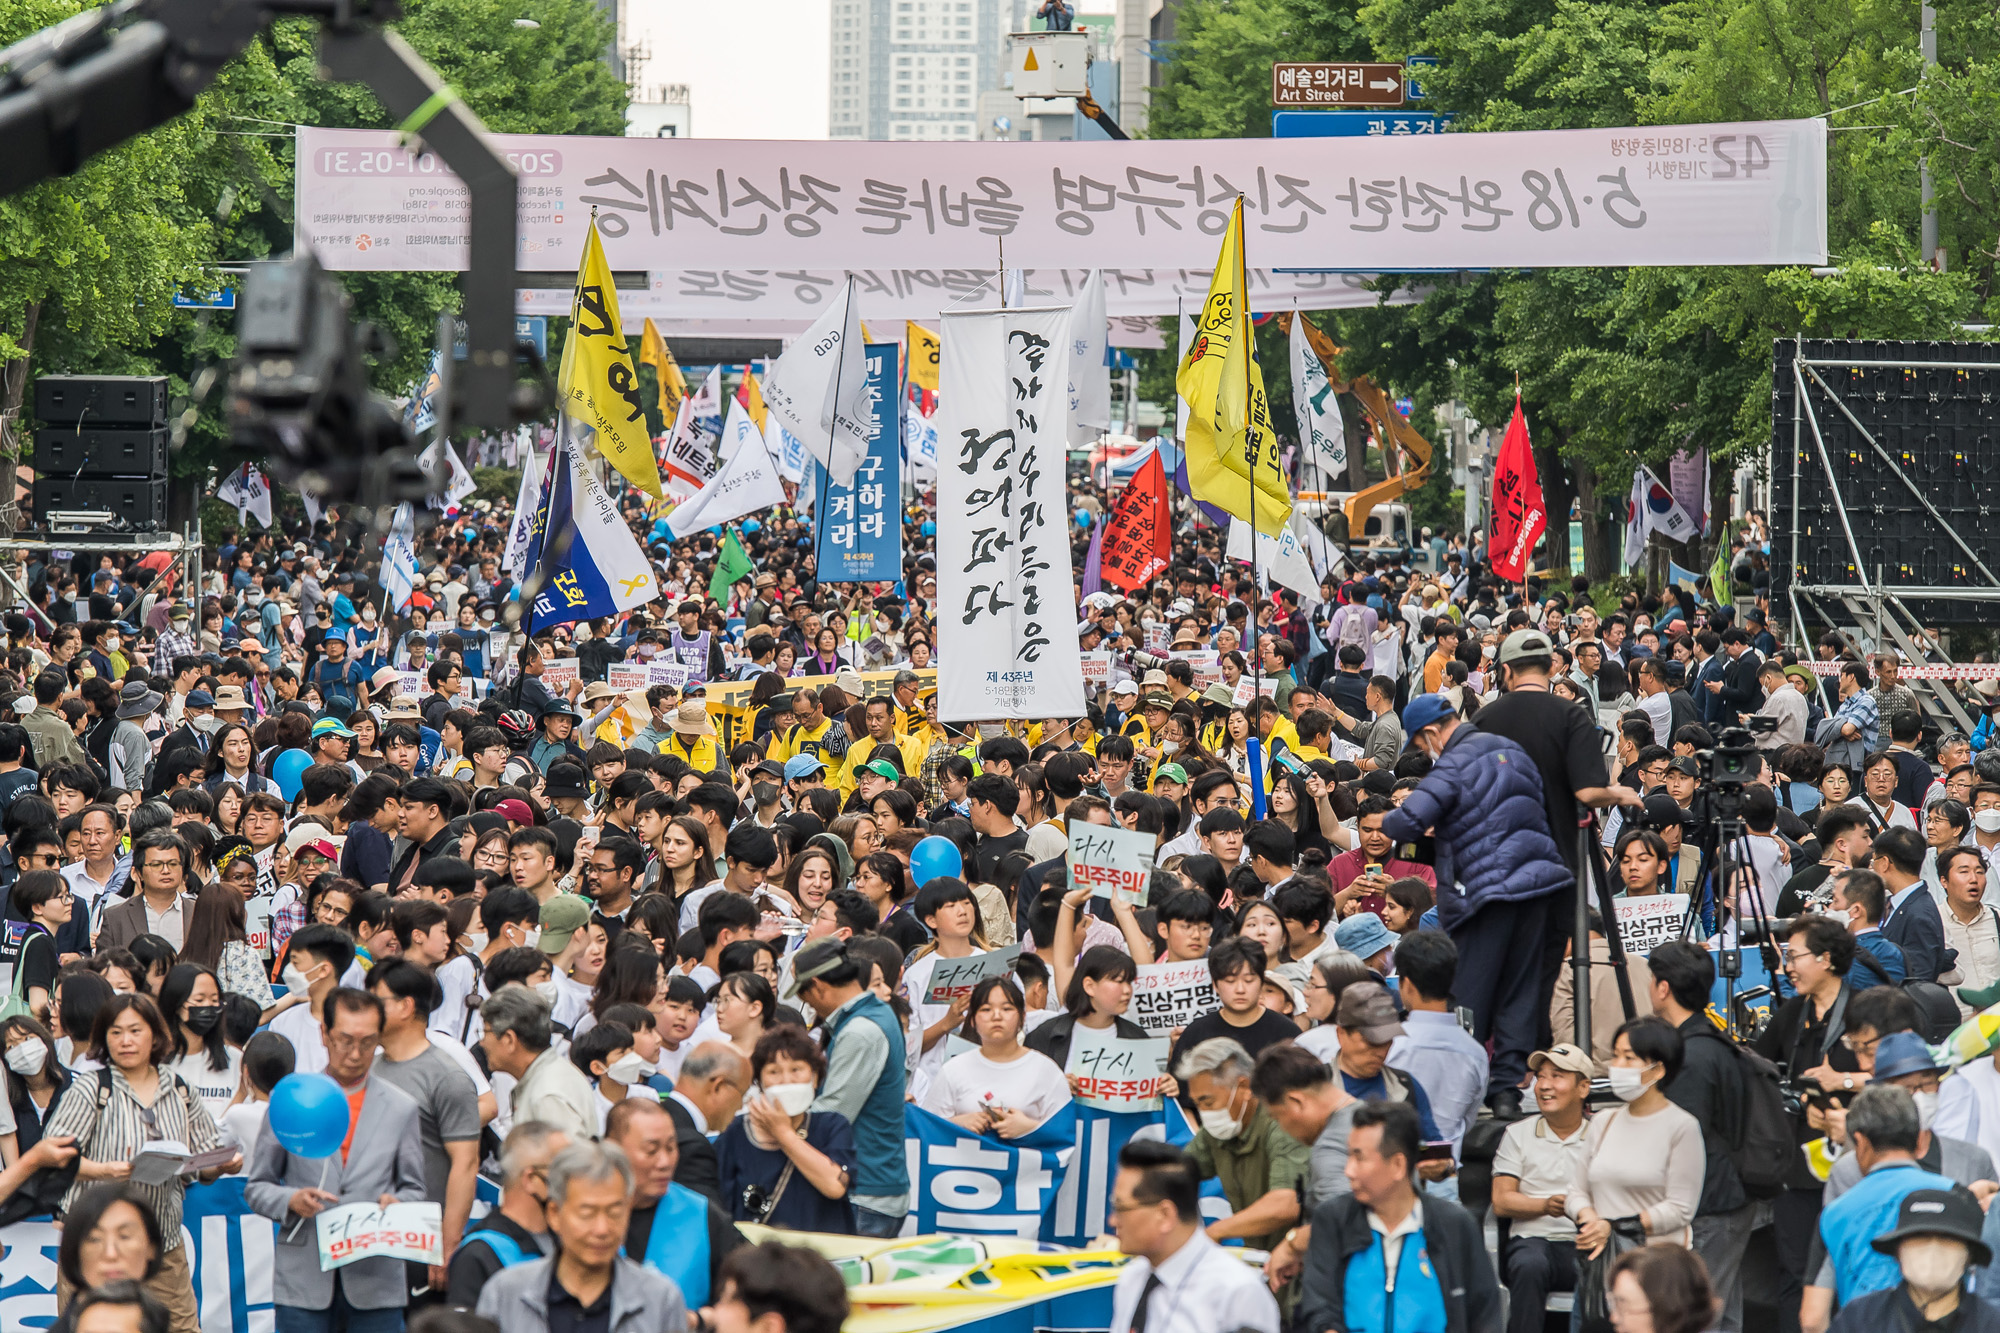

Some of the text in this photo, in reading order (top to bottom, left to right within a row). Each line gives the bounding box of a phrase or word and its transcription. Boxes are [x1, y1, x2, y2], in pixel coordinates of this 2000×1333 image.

[1279, 68, 1364, 88] 예술의거리
[1279, 88, 1345, 101] Art Street
[858, 455, 886, 539] 구하라
[594, 493, 616, 526] 아이들
[460, 638, 481, 651] WCA
[679, 647, 700, 655] 10.29
[986, 670, 1034, 683] 제 43주년
[984, 685, 1036, 697] 5·18민중항쟁
[994, 697, 1027, 708] 기념행사
[1072, 834, 1116, 864] 다시,
[1072, 862, 1147, 894] 민주주의!
[1636, 898, 1676, 916] 완전한
[1622, 937, 1658, 954] 법전문
[938, 960, 986, 987] 다시,
[1161, 966, 1209, 988] 완전한
[1138, 1012, 1189, 1030] 헌법전문
[1081, 1046, 1134, 1077] 다시,
[329, 1230, 436, 1261] 민주주의!
